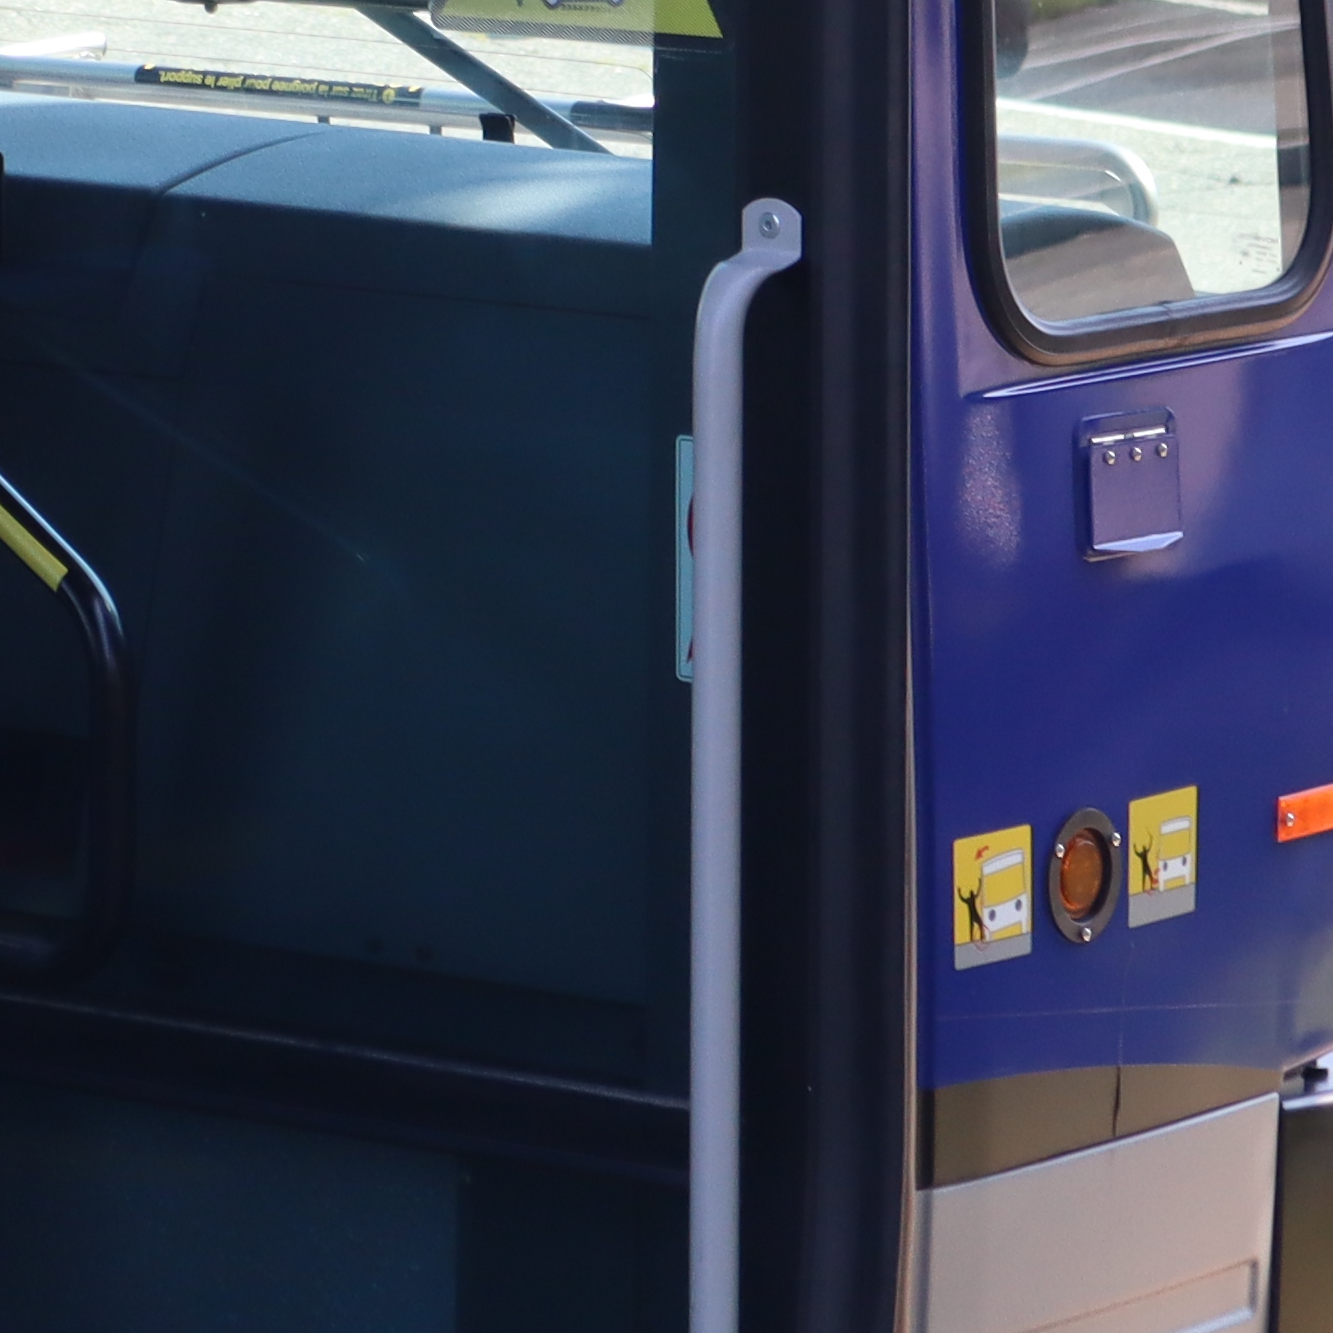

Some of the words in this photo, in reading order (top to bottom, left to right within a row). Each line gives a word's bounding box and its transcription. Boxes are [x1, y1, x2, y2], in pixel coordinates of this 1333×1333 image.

[204, 74, 215, 84] le
[216, 74, 242, 90] plier
[243, 76, 271, 91] pour
